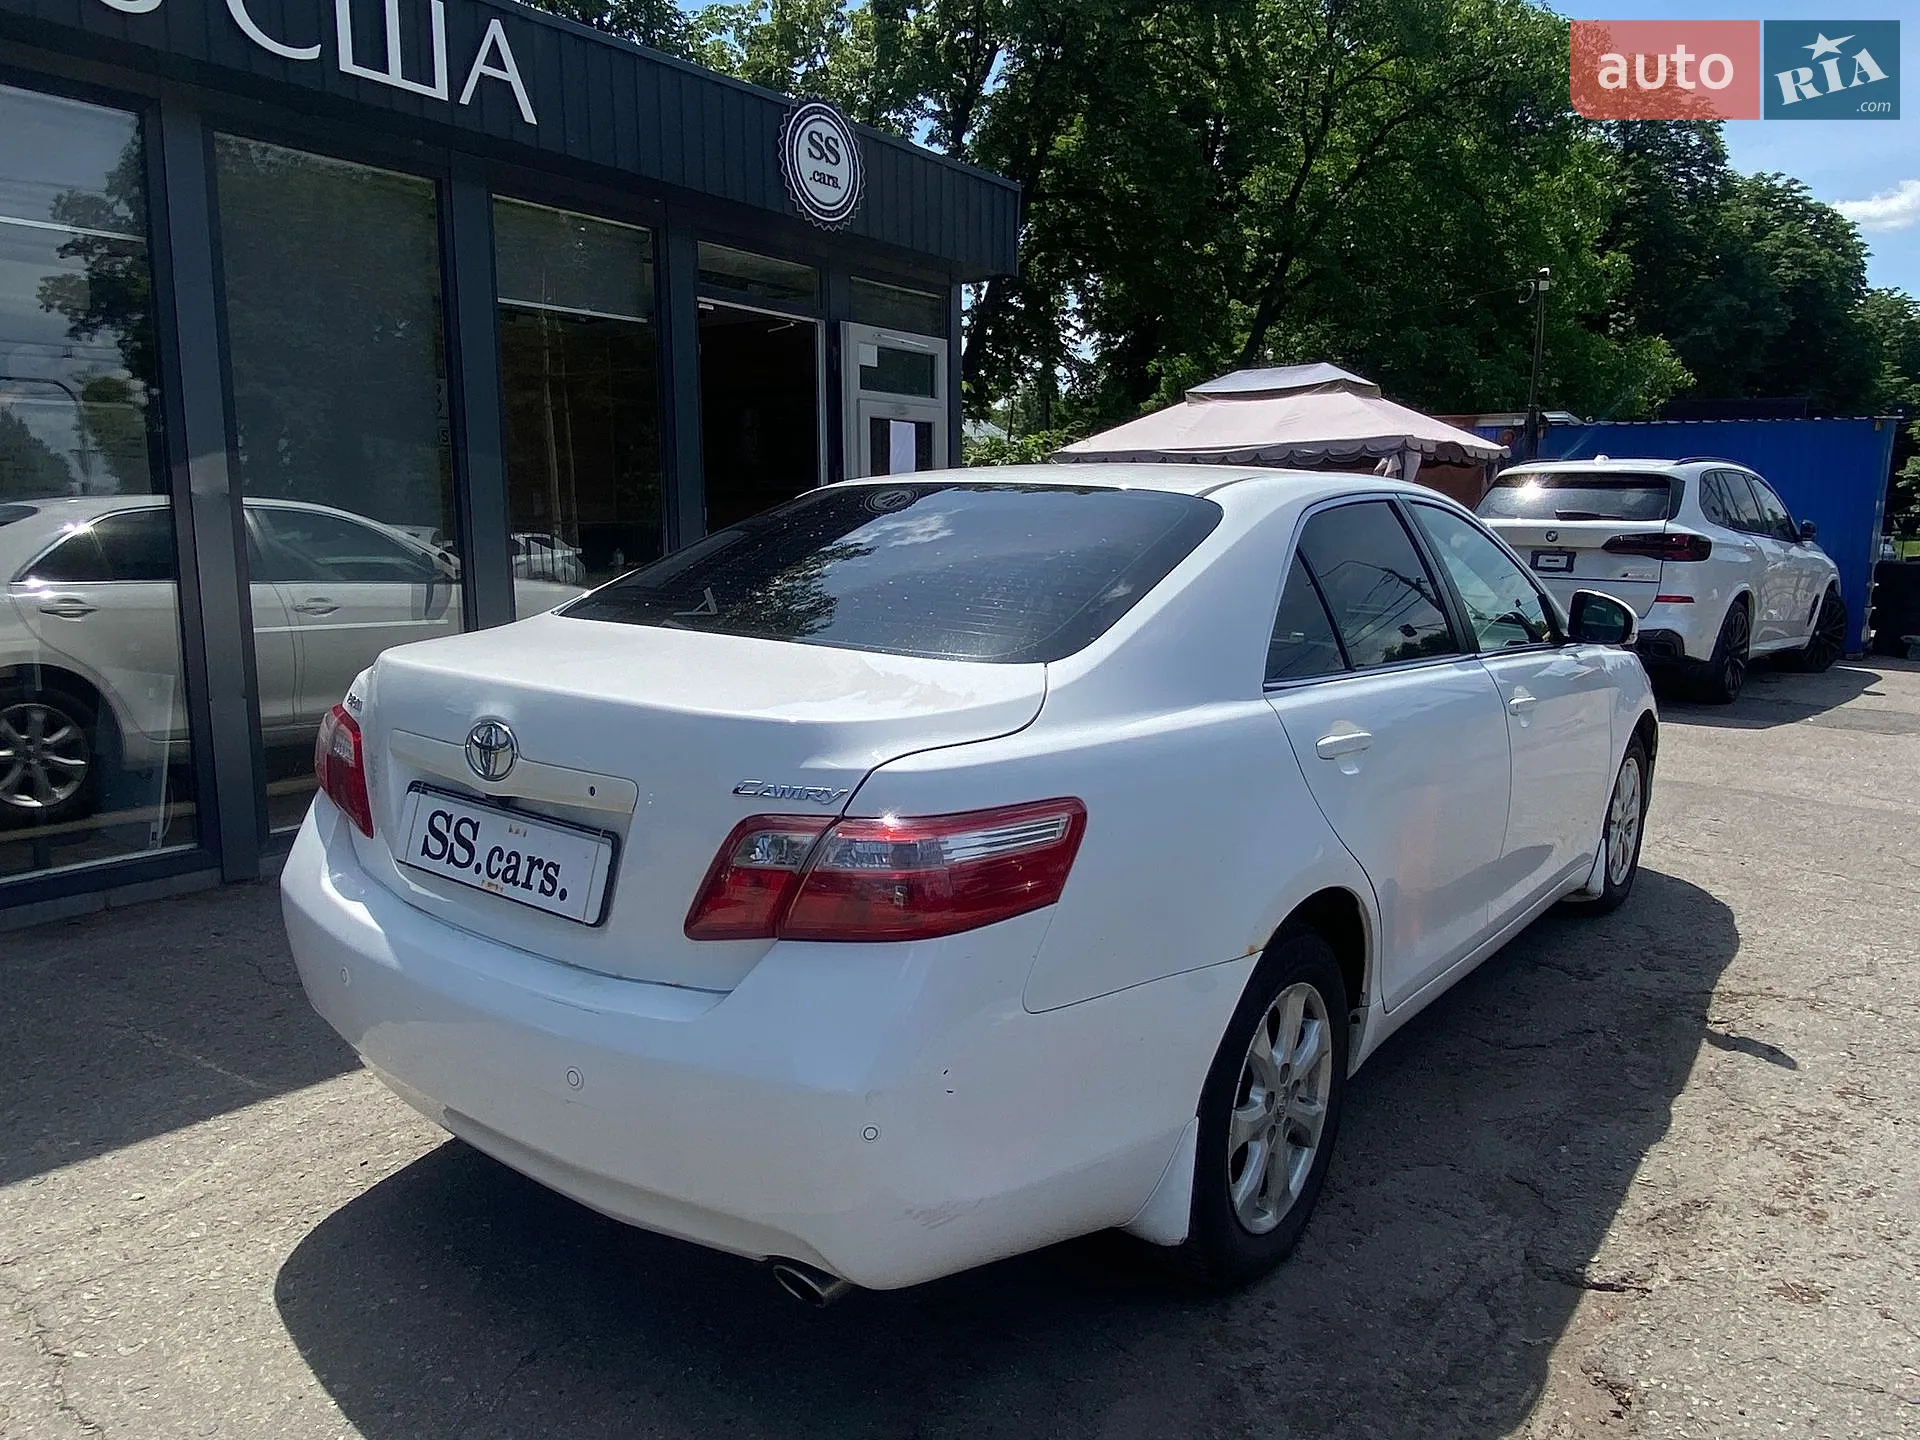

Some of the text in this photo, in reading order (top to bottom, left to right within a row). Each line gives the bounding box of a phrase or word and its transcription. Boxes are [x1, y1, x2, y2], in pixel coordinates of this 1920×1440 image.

[807, 130, 841, 166] SS
[732, 779, 849, 806] CAMRY
[420, 809, 568, 902] SS.cars.
